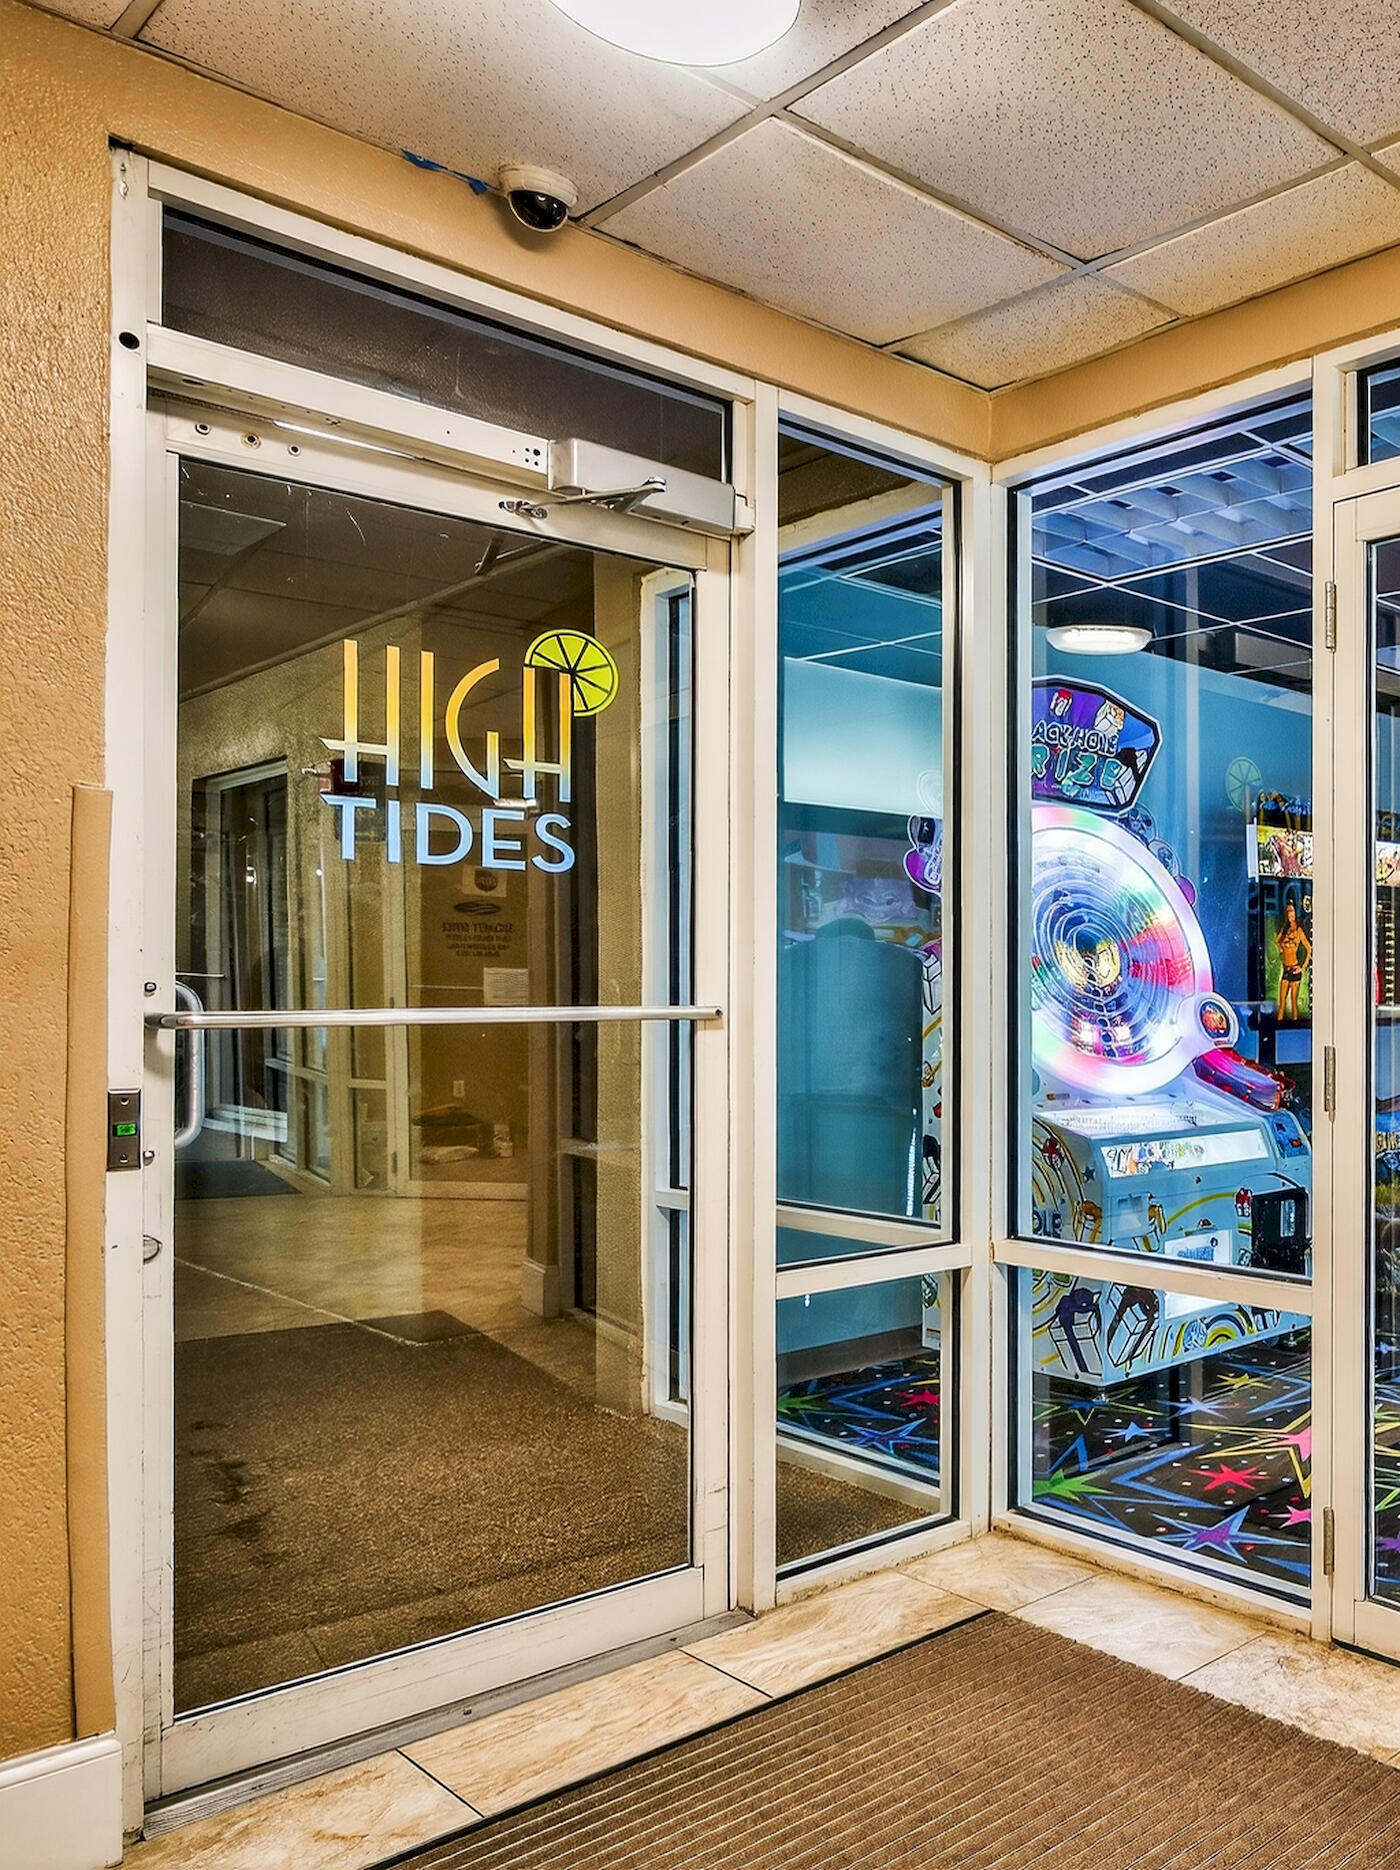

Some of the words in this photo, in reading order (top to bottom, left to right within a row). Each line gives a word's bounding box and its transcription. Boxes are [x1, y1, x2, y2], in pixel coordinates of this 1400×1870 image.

[319, 638, 572, 803] HIGH
[1031, 743, 1128, 789] RIZE
[319, 793, 576, 874] TIDES
